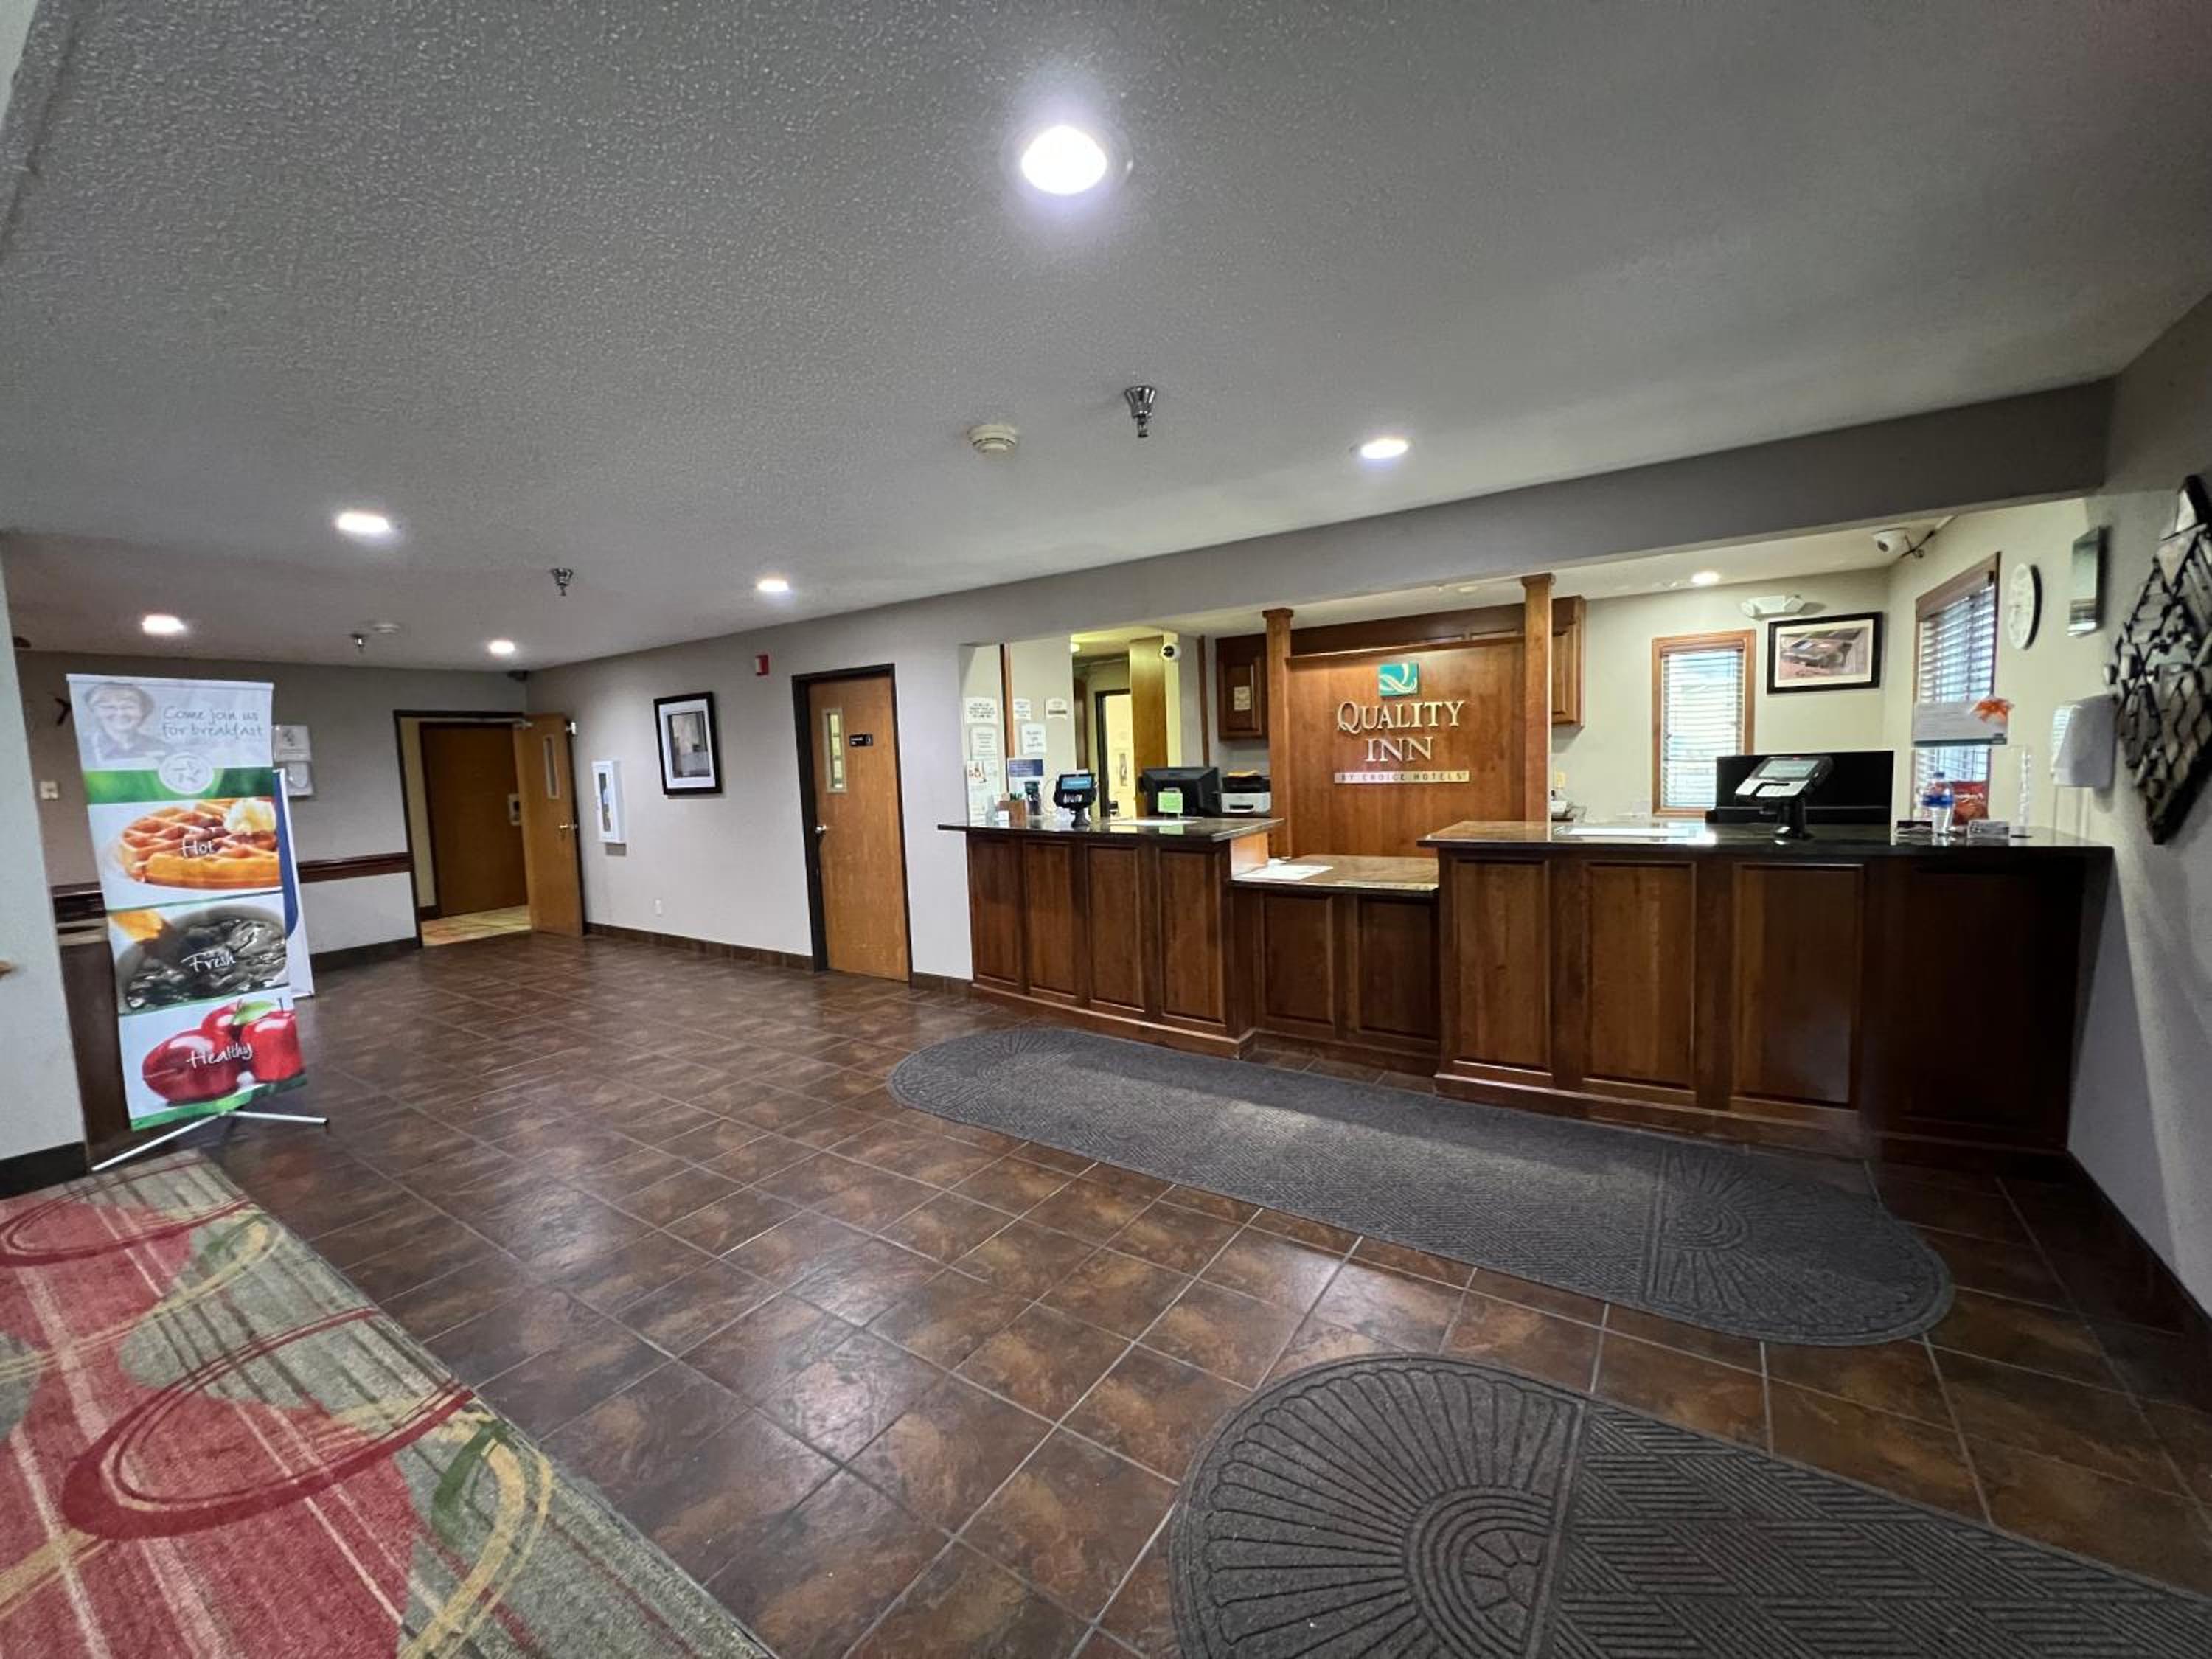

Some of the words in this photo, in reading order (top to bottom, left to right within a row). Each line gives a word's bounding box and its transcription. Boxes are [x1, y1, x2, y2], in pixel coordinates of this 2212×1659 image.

[164, 706, 205, 720] Come
[209, 708, 237, 725] join
[241, 711, 258, 720] us
[1337, 700, 1465, 734] QUALITY
[190, 723, 262, 740] breakfast
[1365, 737, 1433, 762] INN
[182, 840, 214, 858] Hot
[181, 949, 236, 972] Fresh
[186, 1042, 253, 1069] Healthy
